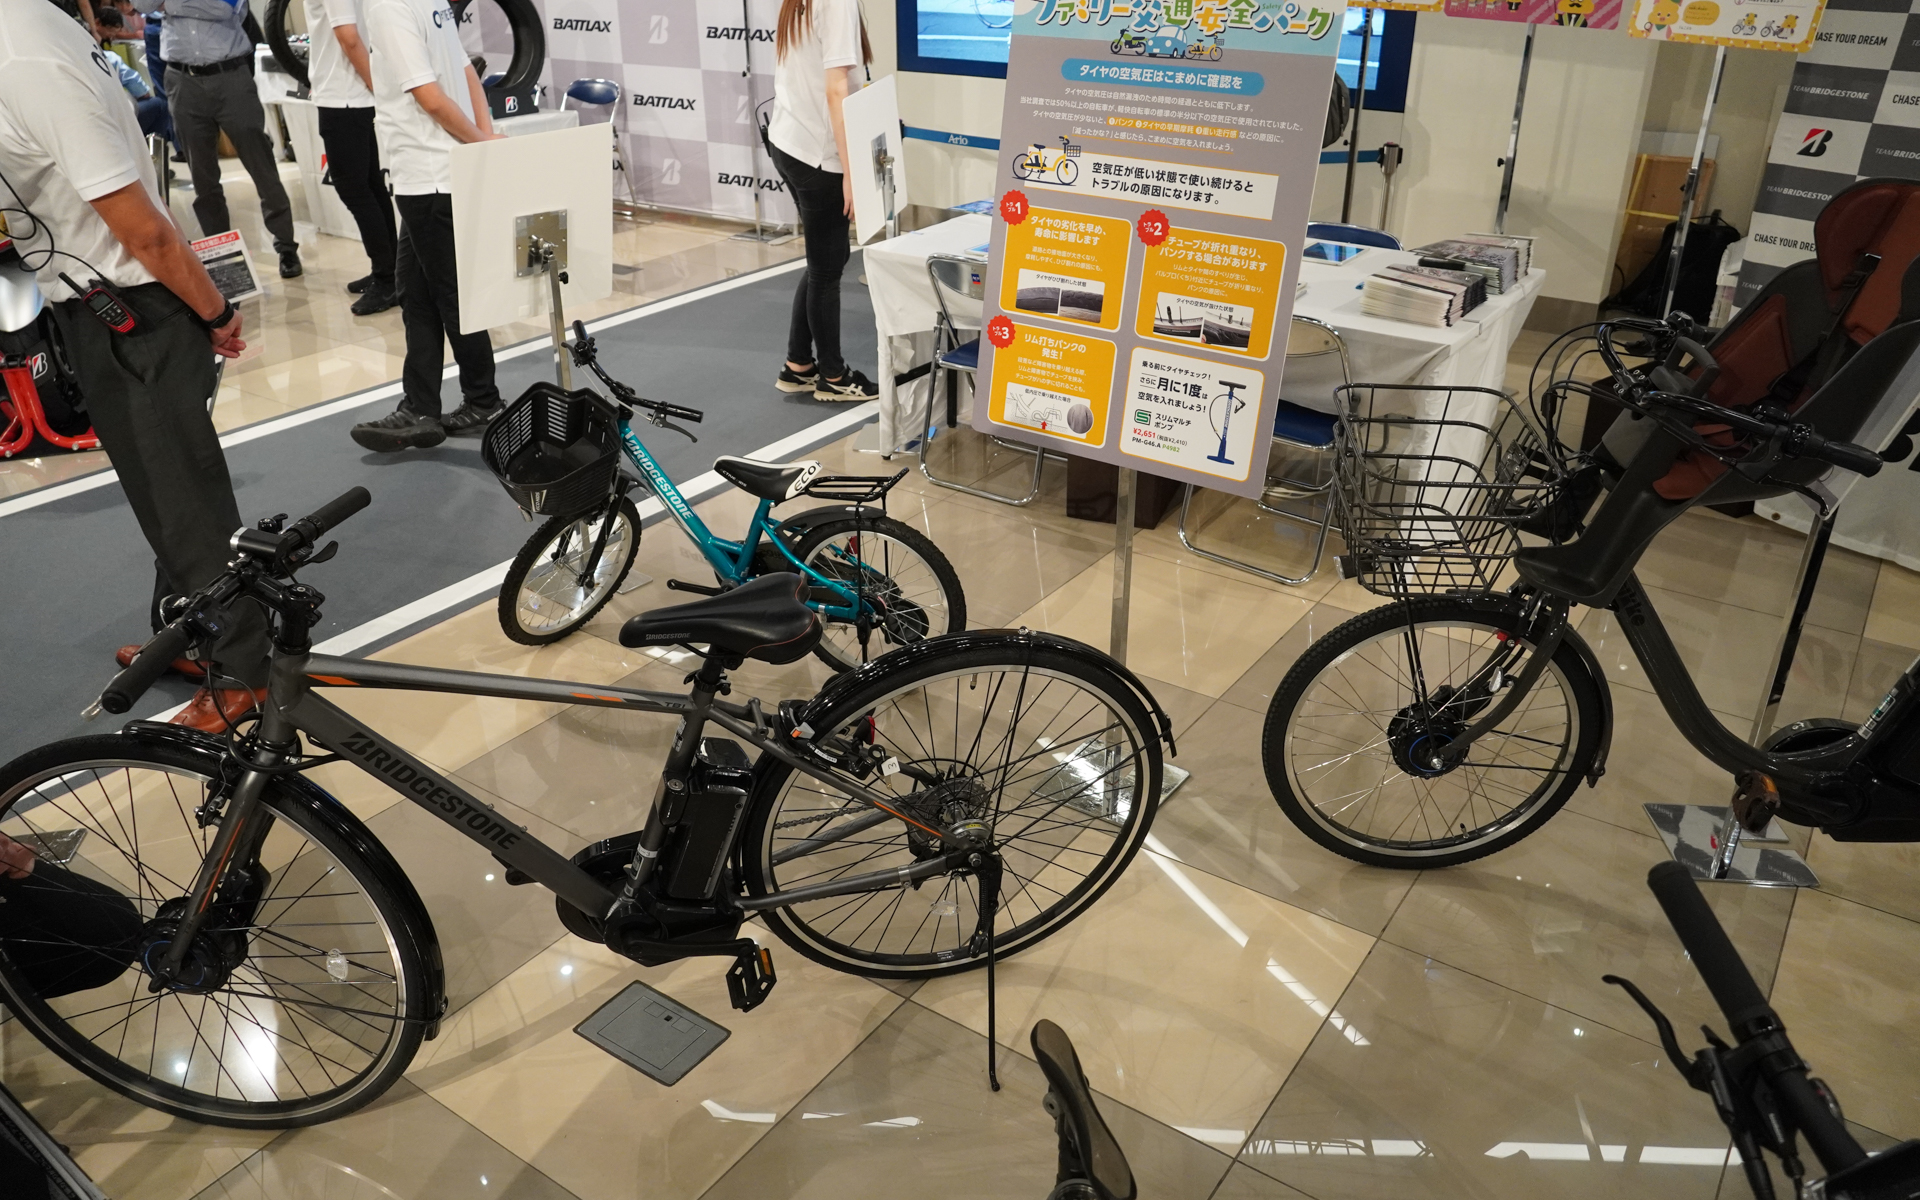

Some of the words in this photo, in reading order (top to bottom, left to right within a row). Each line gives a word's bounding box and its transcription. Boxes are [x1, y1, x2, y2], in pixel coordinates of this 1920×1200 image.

[553, 18, 612, 33] BATTLAX
[1835, 33, 1856, 44] YOUR
[1857, 35, 1888, 46] DREAM
[1080, 65, 1243, 90] タイヤの空気圧はこまめに確認を
[633, 94, 696, 111] BATTLAX
[948, 134, 968, 145] Ario
[1092, 162, 1254, 193] 空気圧が低い状態で使い続けると
[1092, 177, 1219, 205] トラブルの原因になります。
[1031, 216, 1107, 235] タイヤの劣化を早め、
[1034, 228, 1100, 245] 寿命に影響します
[1754, 233, 1778, 245] CHASE
[1779, 237, 1798, 249] YOUR
[1168, 236, 1261, 259] チューブが折れ重なり、
[1159, 247, 1268, 272] パンクする場合があります
[1025, 333, 1086, 353] リム打ちパンクの
[1155, 413, 1191, 427] スリムマルチ
[1133, 428, 1156, 438] ¥2,651
[625, 440, 693, 519] BRIDGESTONE
[340, 731, 521, 850] BRIDGESTONE
